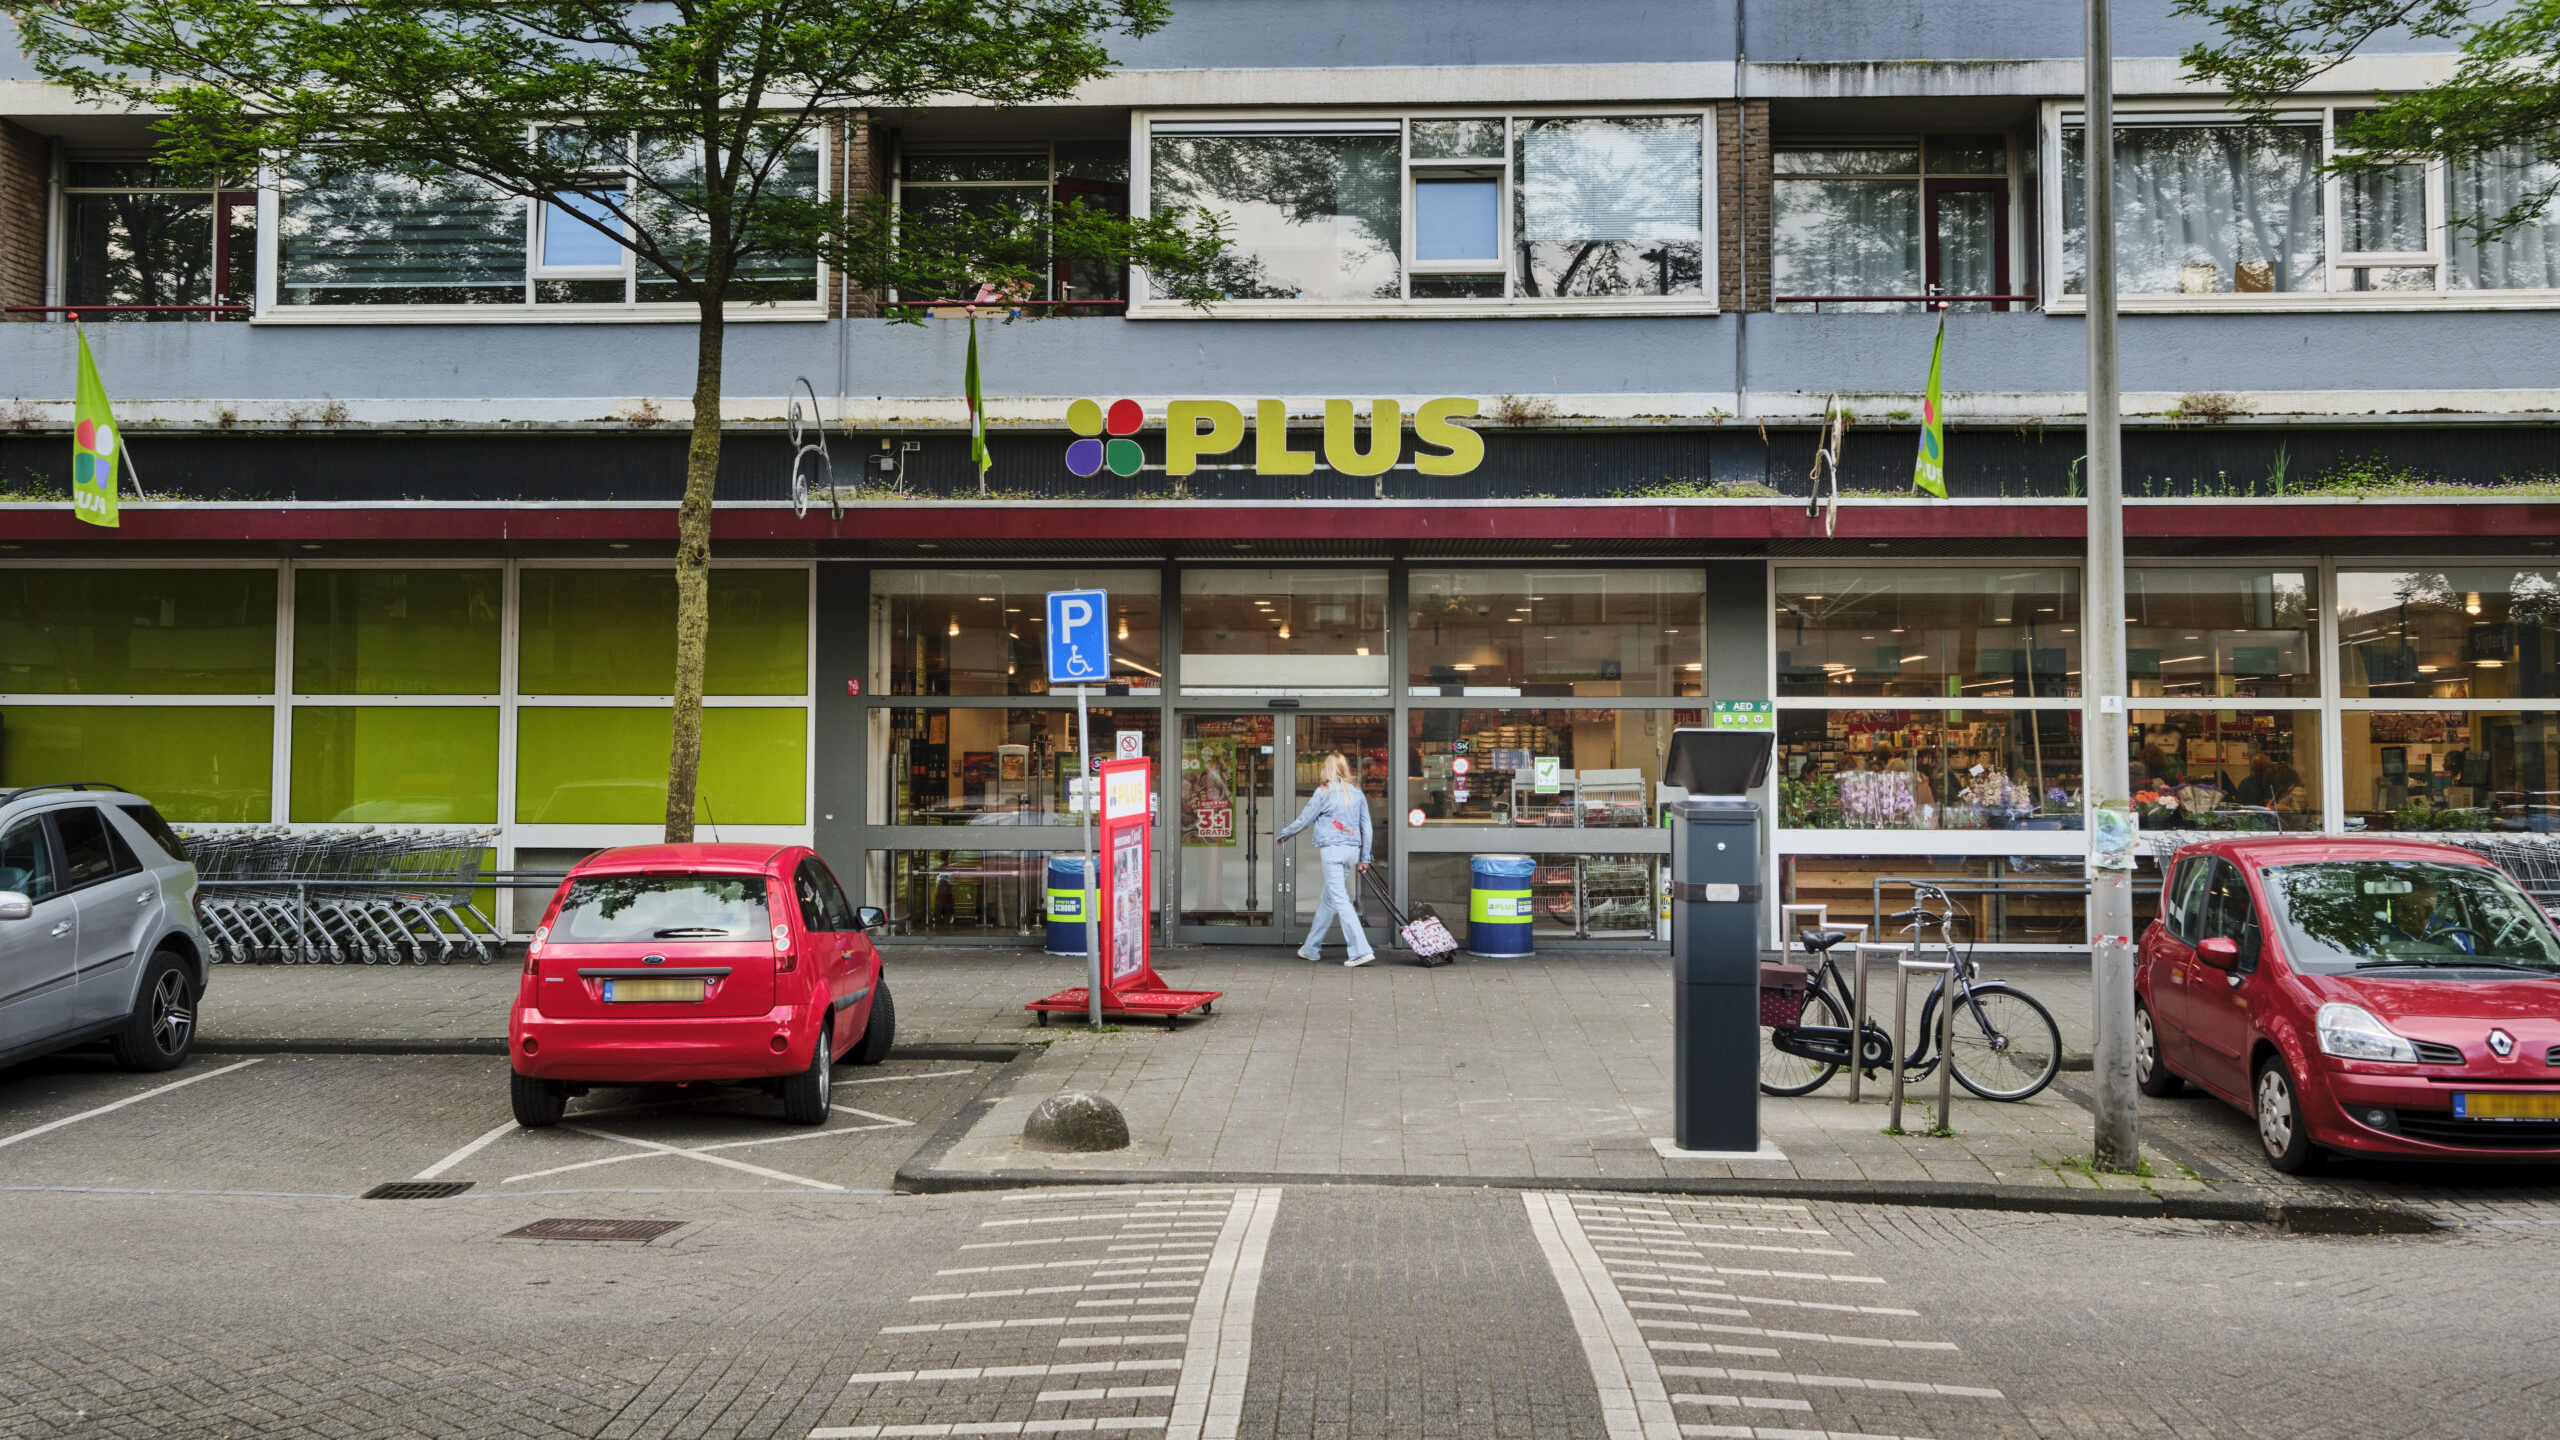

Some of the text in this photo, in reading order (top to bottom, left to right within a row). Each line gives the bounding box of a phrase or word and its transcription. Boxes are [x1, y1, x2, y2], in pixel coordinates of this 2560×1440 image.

[1166, 398, 1485, 476] PLUS
[1061, 599, 1092, 644] P
[1733, 702, 1753, 710] AED
[1181, 758, 1200, 770] BQ
[1118, 781, 1143, 805] PLUS
[1199, 810, 1231, 829] 3+1
